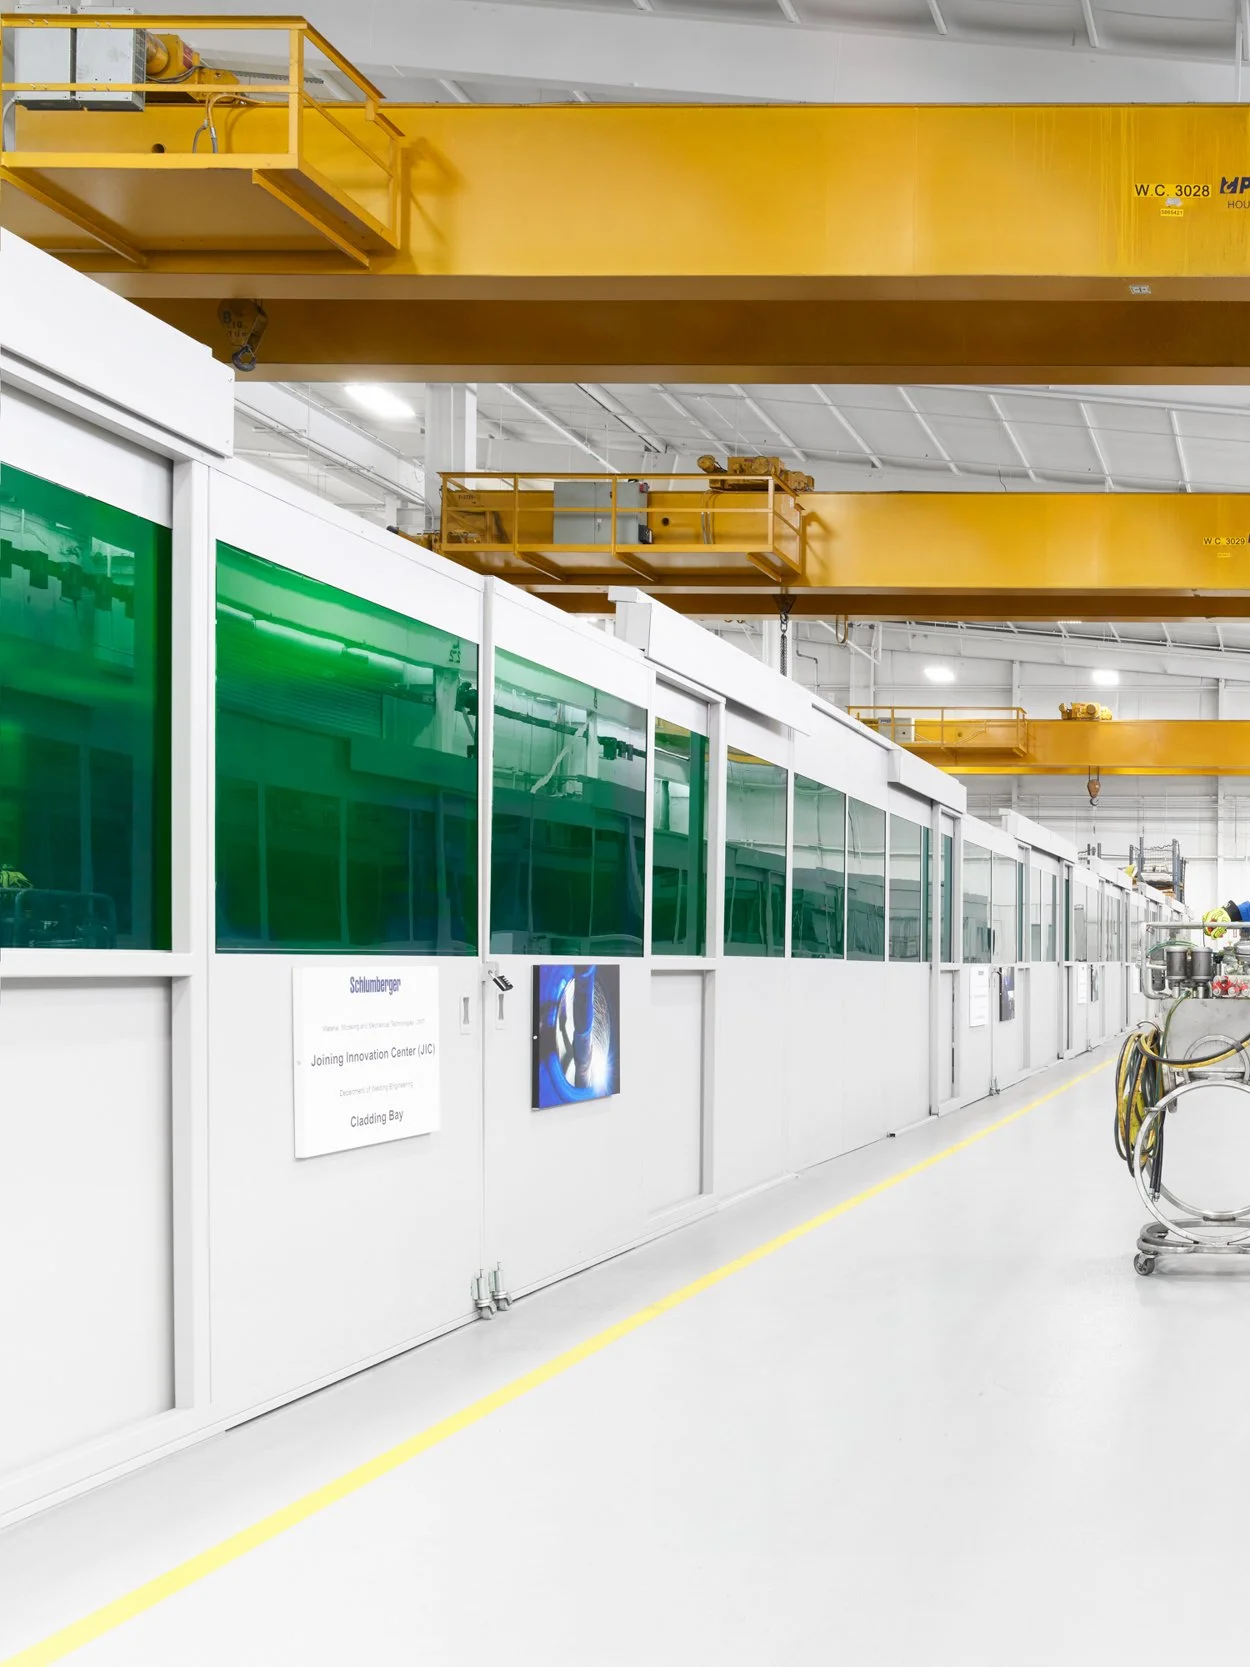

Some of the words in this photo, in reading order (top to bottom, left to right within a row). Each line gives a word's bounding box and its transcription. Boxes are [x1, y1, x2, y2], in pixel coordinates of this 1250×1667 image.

[1135, 184, 1169, 197] W.C.
[1175, 184, 1210, 197] 3028
[1225, 537, 1246, 545] 3029
[349, 975, 402, 996] Schlumberger
[310, 1053, 344, 1067] Joining
[346, 1048, 389, 1063] Innovation
[390, 1045, 416, 1059] Center
[417, 1042, 436, 1058] (JIC)
[350, 1112, 387, 1128] Cladding
[388, 1109, 404, 1122] Bay
